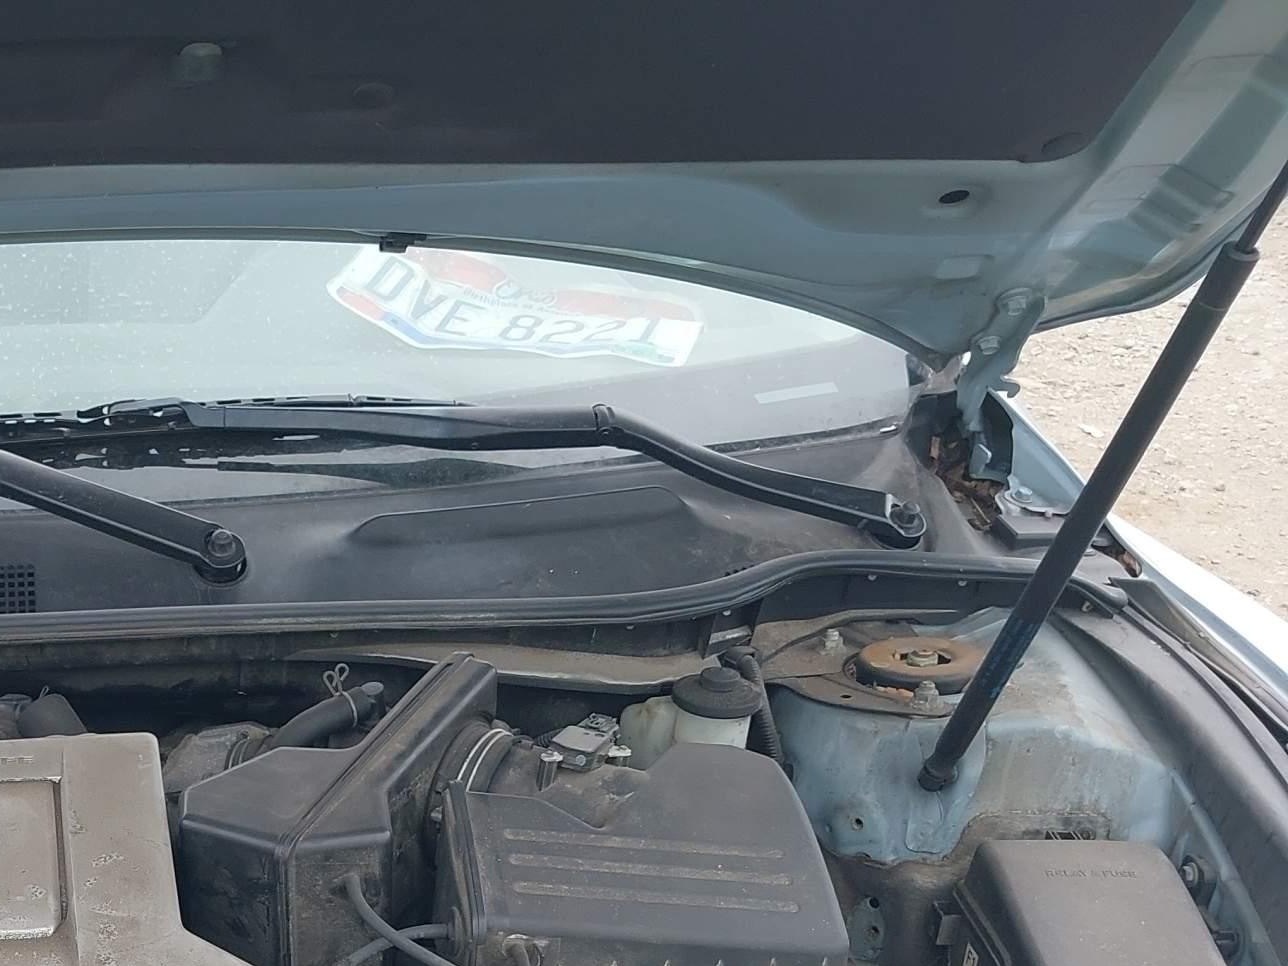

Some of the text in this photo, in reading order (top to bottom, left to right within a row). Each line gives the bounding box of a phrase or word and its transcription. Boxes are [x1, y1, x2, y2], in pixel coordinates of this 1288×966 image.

[365, 255, 660, 345] DVE 8221
[1044, 868, 1087, 878] RELAY
[1101, 869, 1138, 879] FUSE
